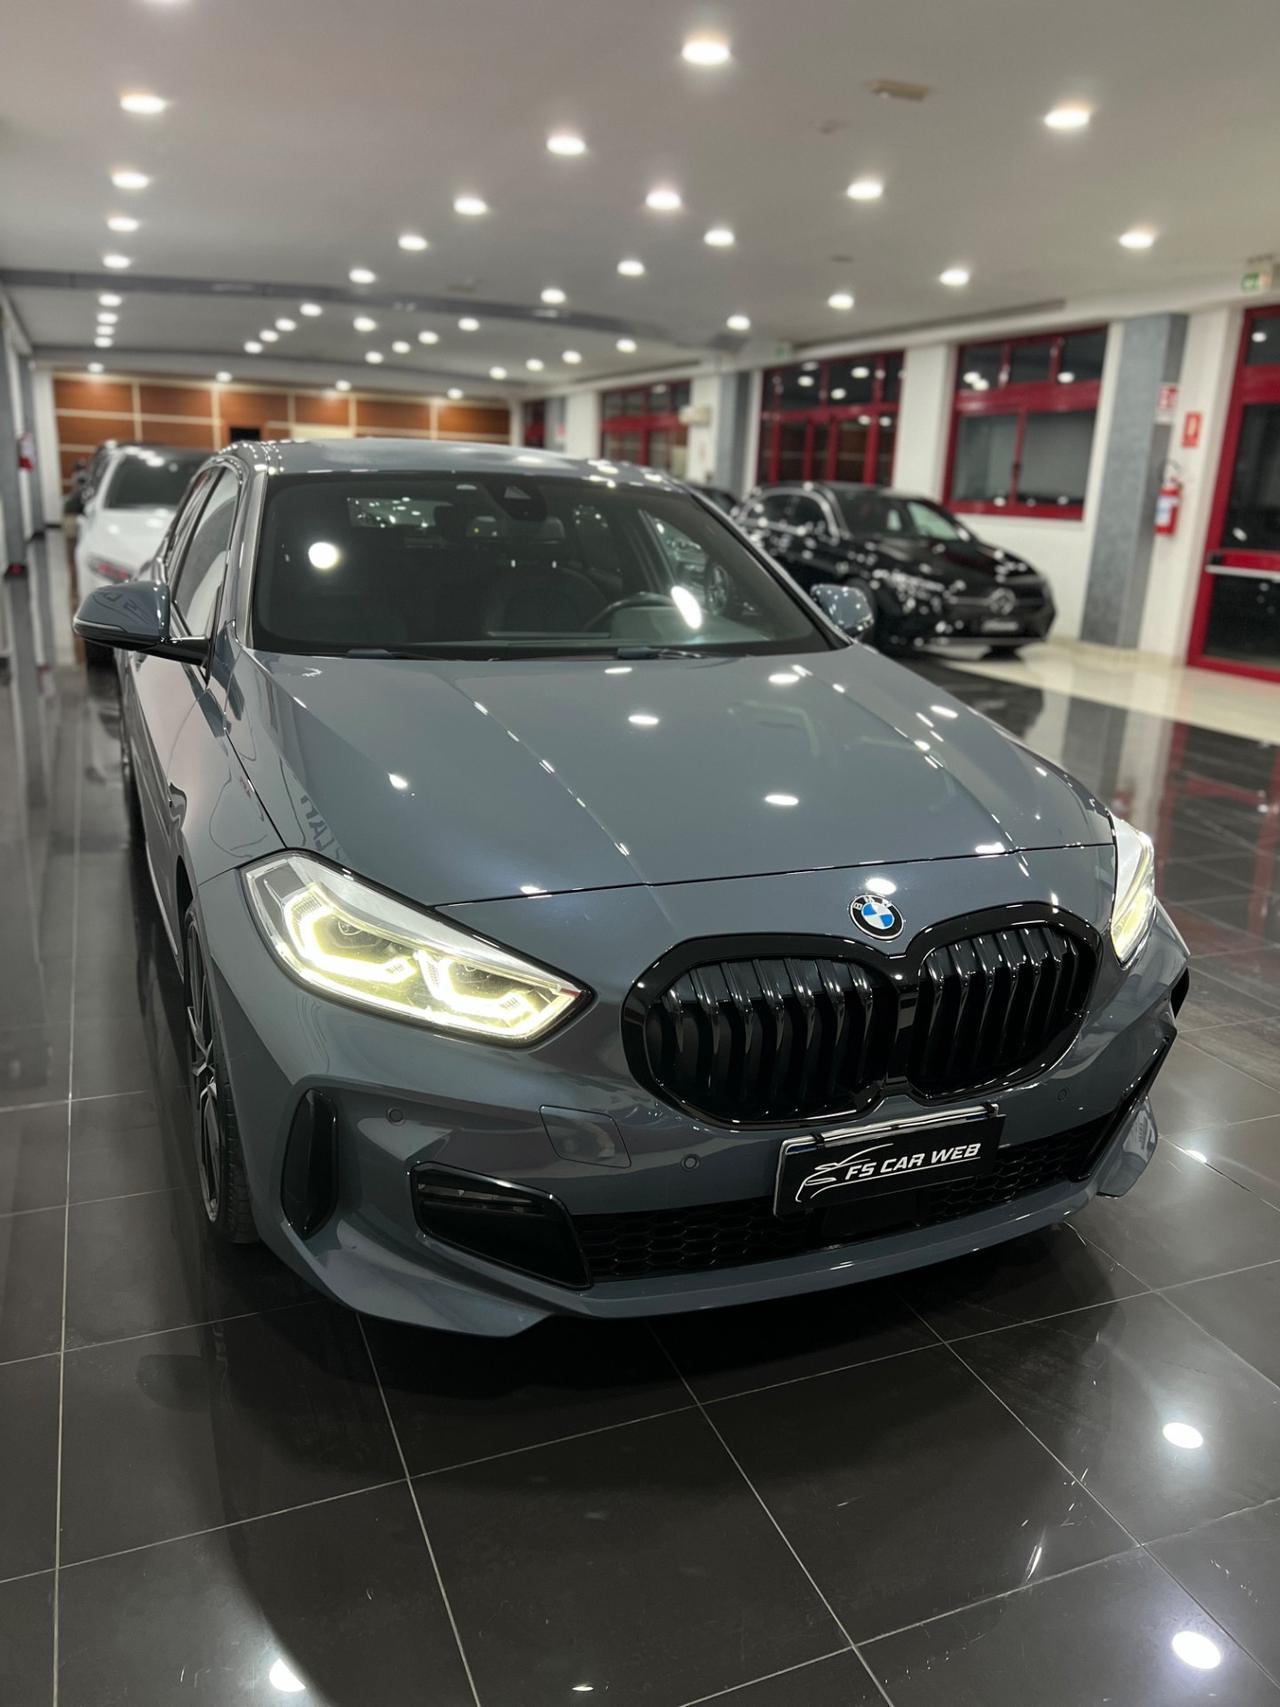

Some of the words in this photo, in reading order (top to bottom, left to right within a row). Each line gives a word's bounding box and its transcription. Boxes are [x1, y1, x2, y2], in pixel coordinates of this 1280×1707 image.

[852, 895, 893, 910] BMW
[845, 1162, 877, 1180] FS
[880, 1154, 925, 1173] CAR
[931, 1143, 981, 1163] WEB
